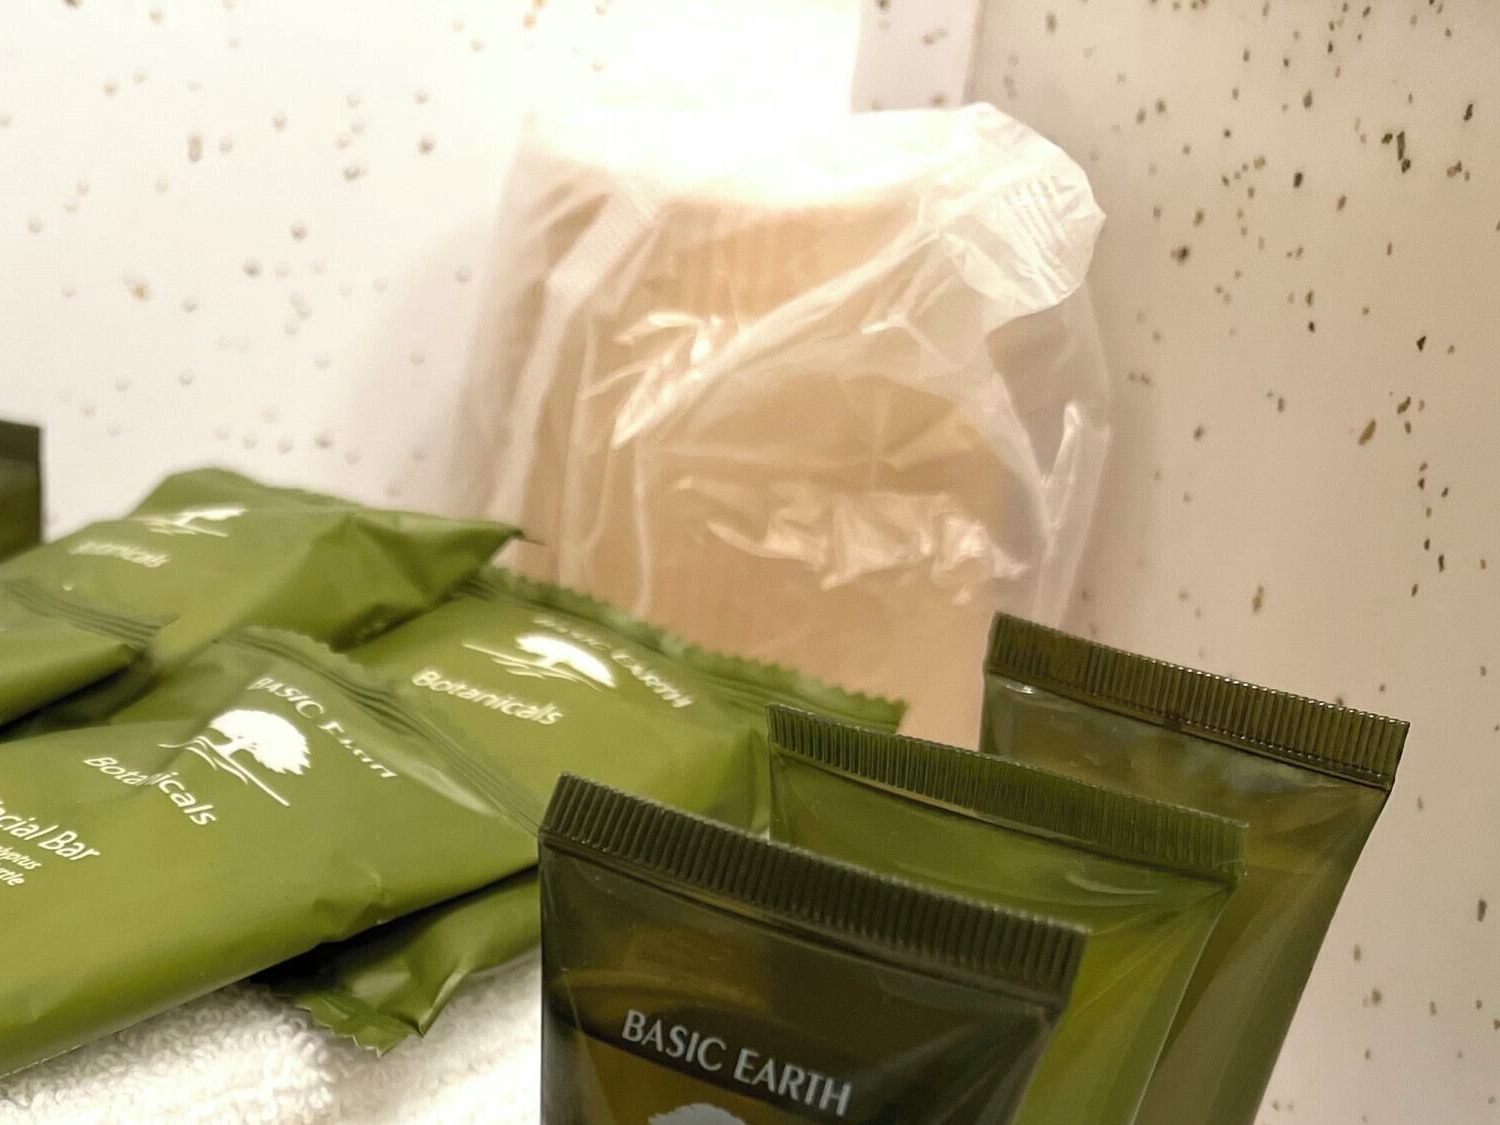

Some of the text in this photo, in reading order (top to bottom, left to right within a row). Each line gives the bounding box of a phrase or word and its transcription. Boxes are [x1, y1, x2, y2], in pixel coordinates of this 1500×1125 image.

[247, 676, 325, 719] BASIC
[411, 668, 564, 724] Botanicals
[37, 829, 100, 861] Bar
[621, 1009, 852, 1117] BASIC EARTH
